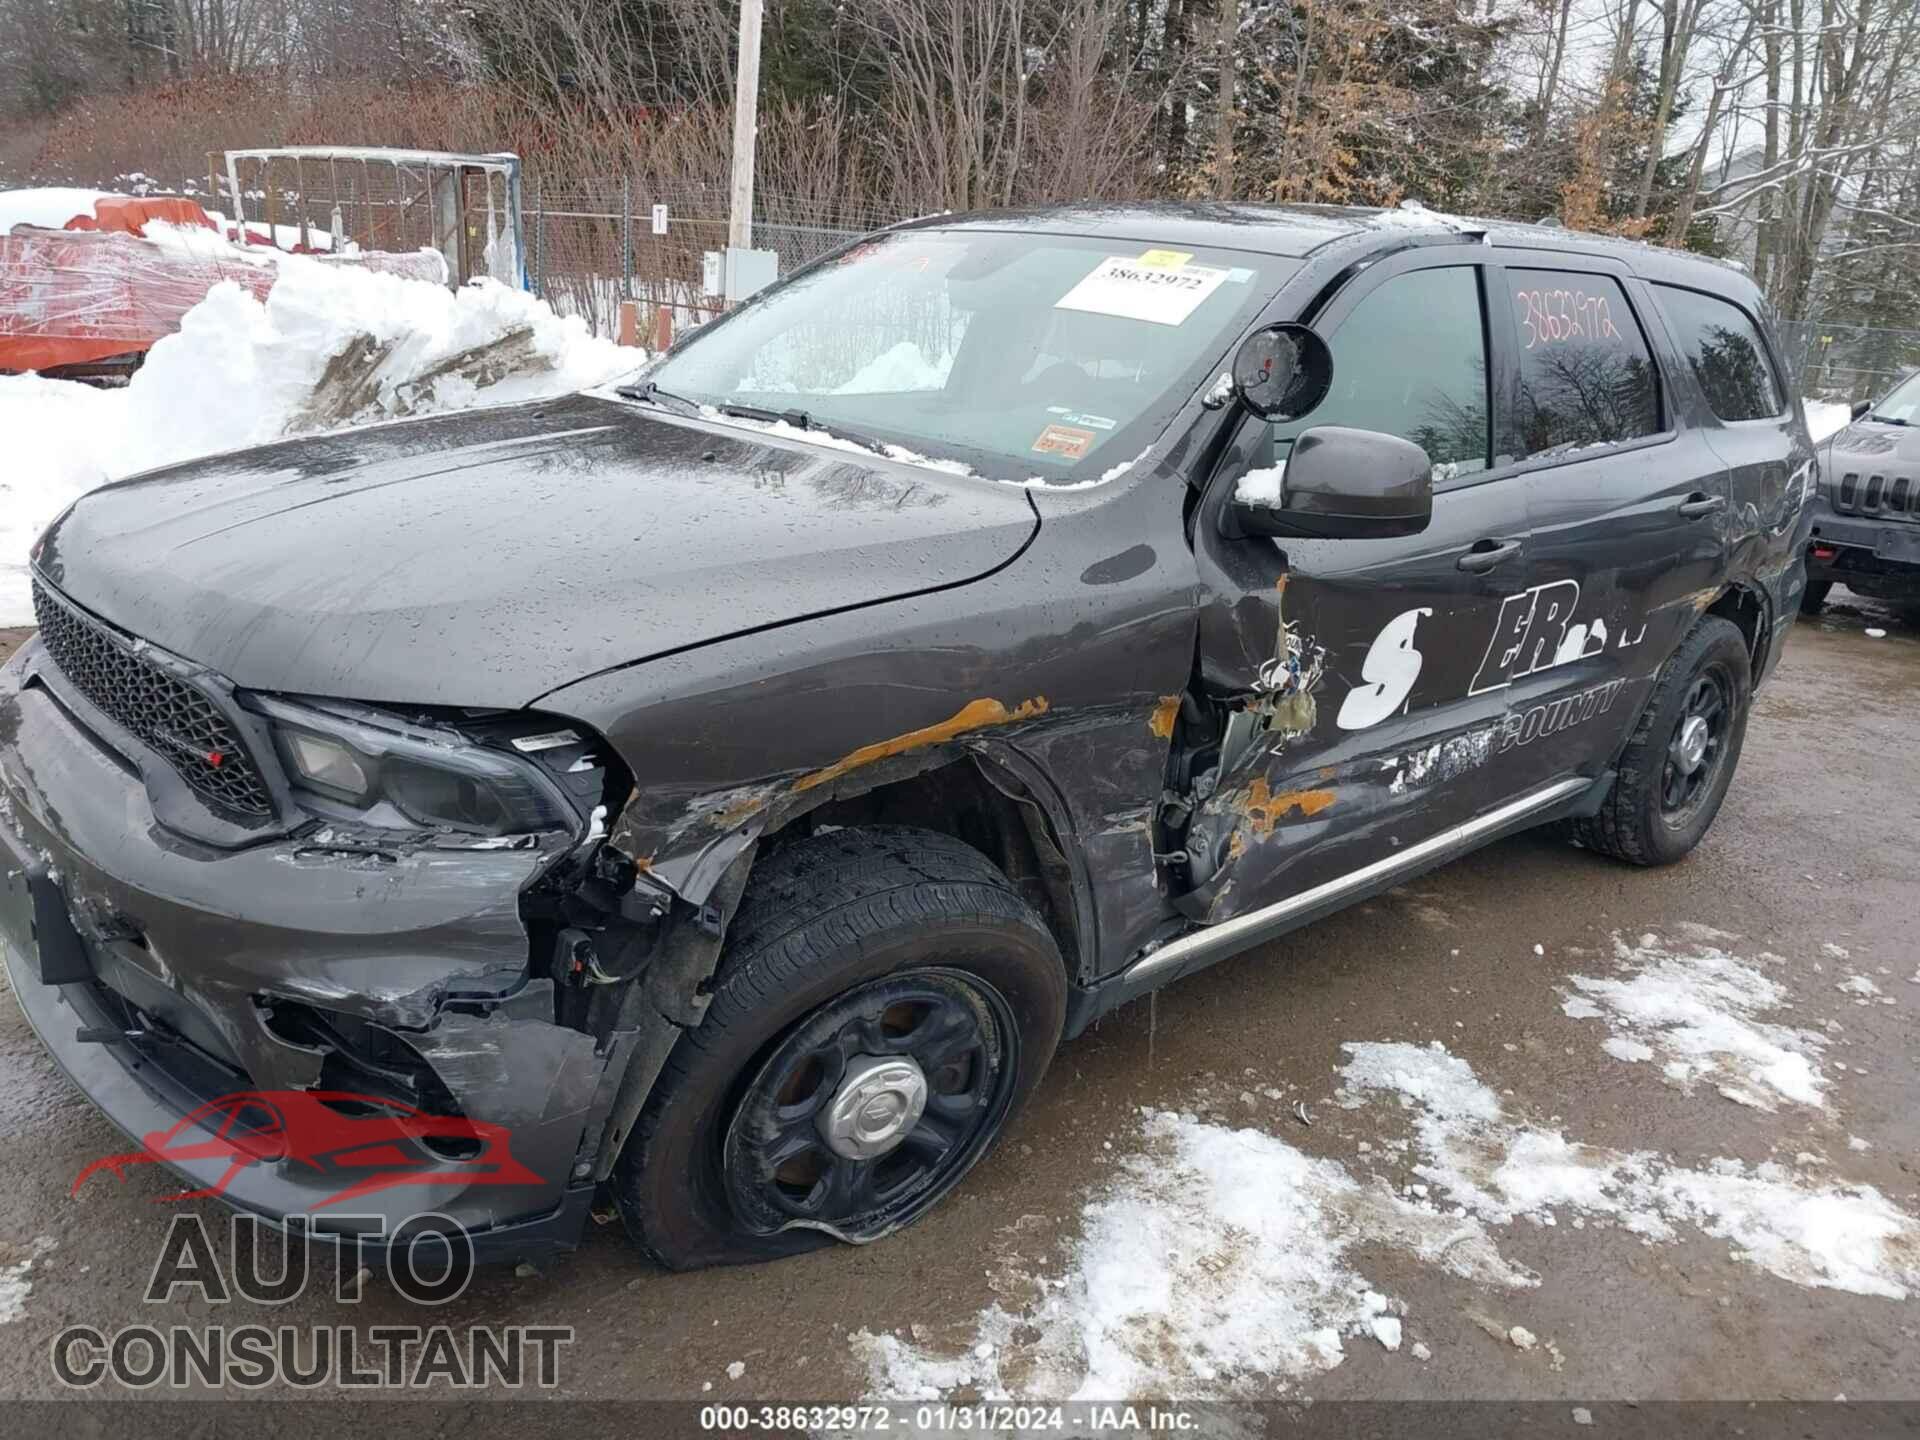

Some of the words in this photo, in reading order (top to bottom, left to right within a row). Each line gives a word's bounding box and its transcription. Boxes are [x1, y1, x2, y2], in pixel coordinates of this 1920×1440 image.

[1107, 267, 1203, 290] 38632972
[1518, 289, 1623, 349] 38632972
[1498, 677, 1628, 754] COUNTY
